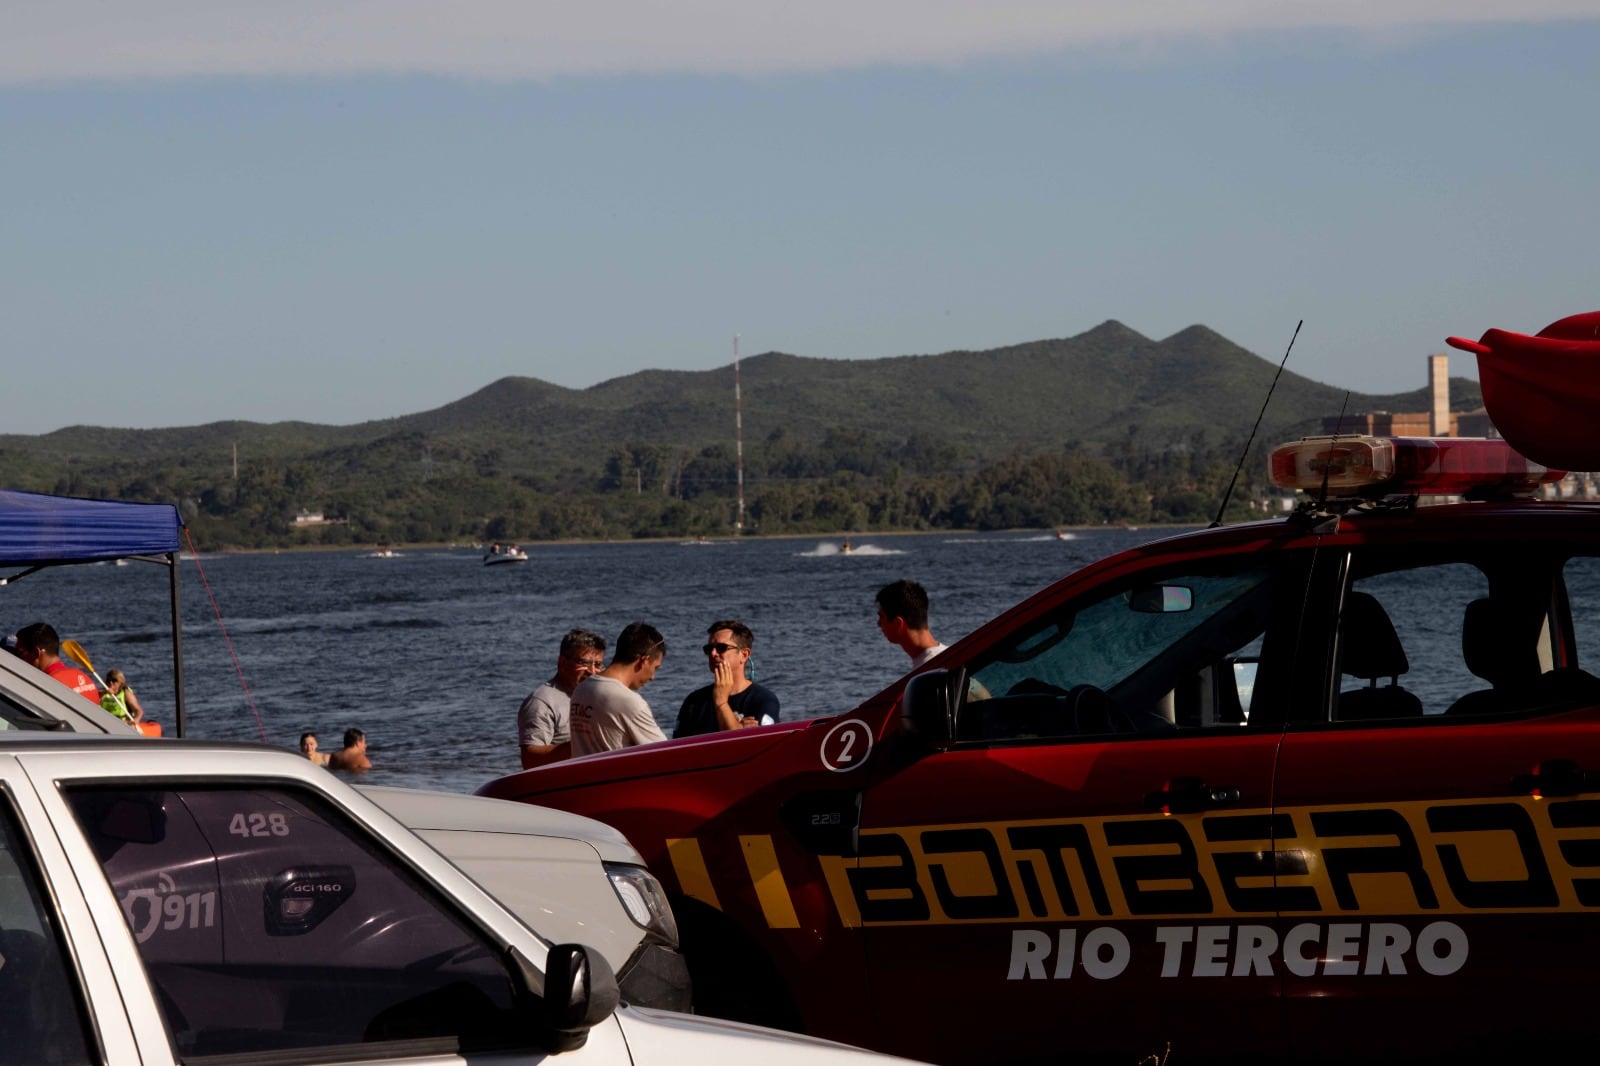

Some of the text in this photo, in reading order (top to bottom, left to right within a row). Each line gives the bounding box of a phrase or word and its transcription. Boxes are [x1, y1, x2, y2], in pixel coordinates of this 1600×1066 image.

[836, 730, 857, 762] 2
[229, 812, 290, 838] 428
[316, 884, 342, 892] 160
[163, 891, 216, 931] 911
[1006, 920, 1470, 980] RIO TERCERO
